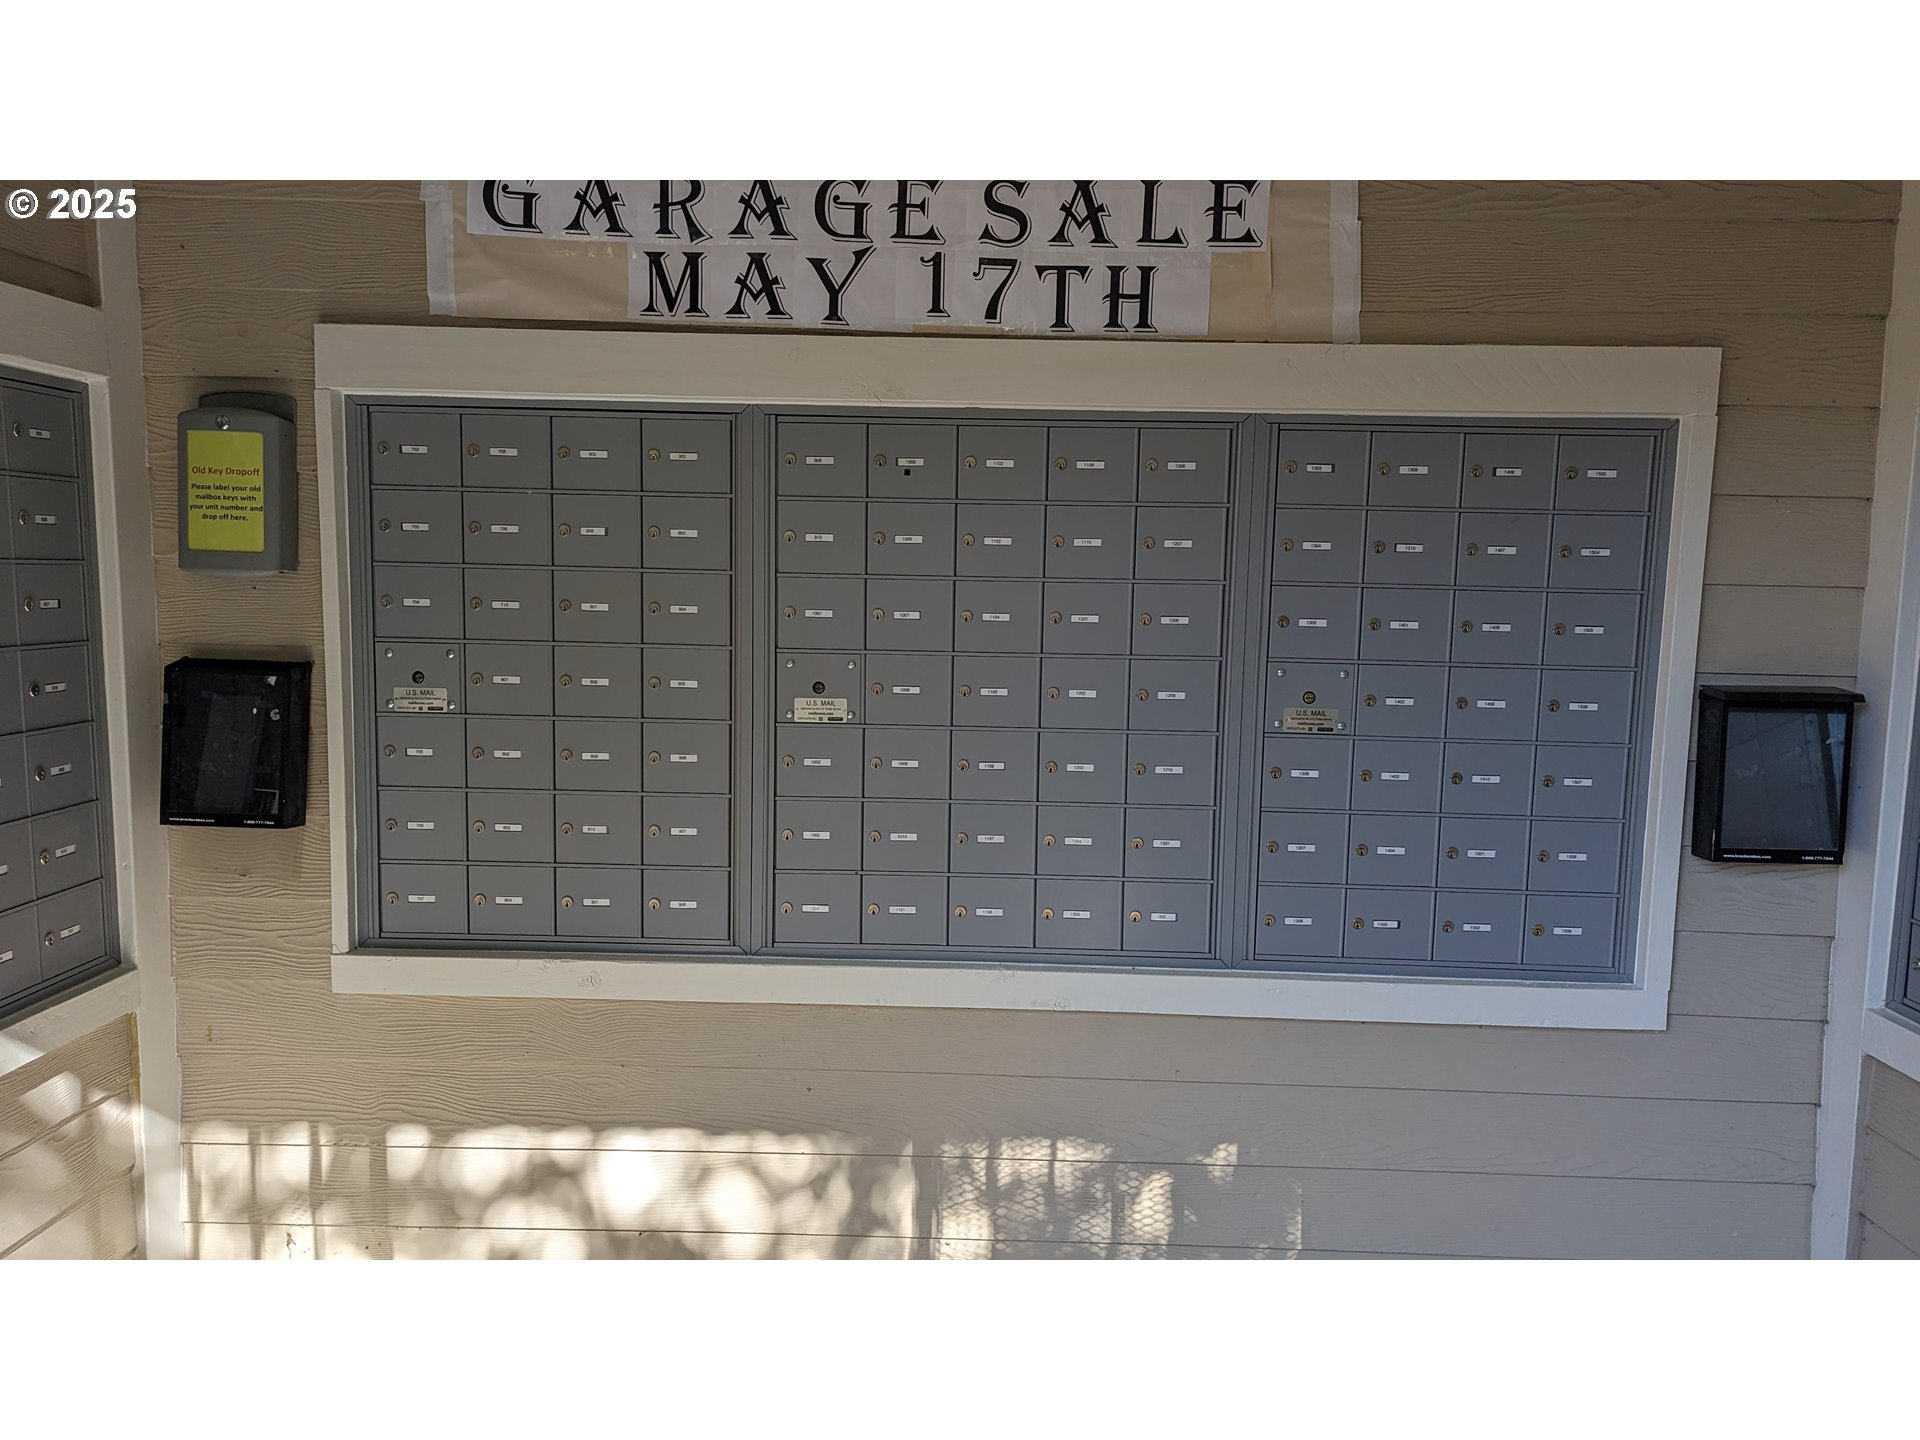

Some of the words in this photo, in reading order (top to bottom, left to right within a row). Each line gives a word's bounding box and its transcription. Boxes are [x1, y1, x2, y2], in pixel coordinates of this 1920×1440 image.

[482, 180, 947, 245] GARAGE
[978, 180, 1263, 248] SALE
[640, 245, 877, 326] MAY
[920, 251, 1159, 333] 17TH
[192, 466, 206, 474] Old
[208, 467, 223, 476] Key
[225, 467, 260, 477] Dropoff
[222, 494, 239, 502] keys
[201, 513, 218, 521] drop
